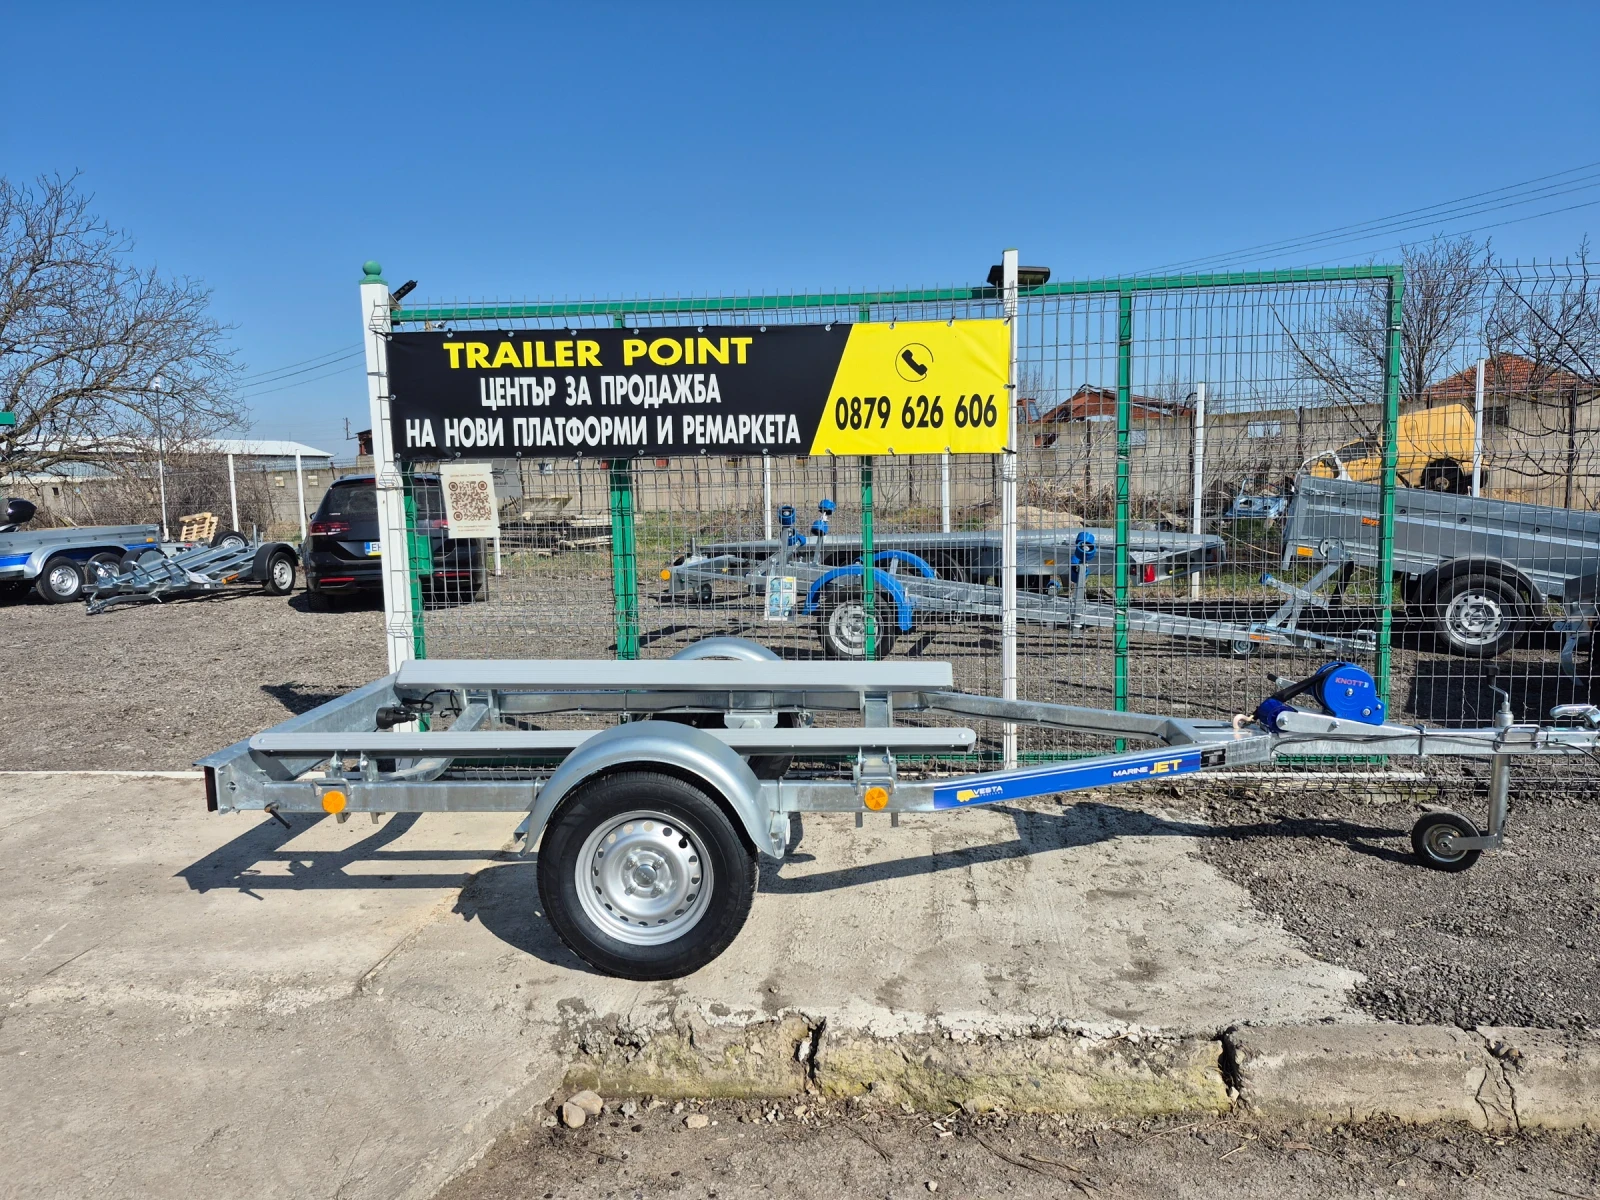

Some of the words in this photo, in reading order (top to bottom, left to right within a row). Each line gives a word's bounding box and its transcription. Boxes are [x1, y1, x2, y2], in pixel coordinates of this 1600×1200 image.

[443, 340, 603, 368] TRAILER
[623, 337, 752, 365] POINT
[481, 377, 556, 410] ЦЕНТЪР
[565, 376, 592, 406] ЗА
[601, 374, 721, 408] ПРОДАЖБА
[836, 396, 890, 430] 0879
[902, 395, 943, 429] 626
[955, 394, 996, 427] 606
[406, 419, 436, 448] НА
[445, 418, 504, 447] НОВИ
[513, 416, 647, 447] ПЛАТФОРМИ
[657, 416, 673, 444] И
[683, 414, 800, 444] РЕМАРКЕТА
[1335, 677, 1363, 687] KNOTT
[1113, 767, 1148, 777] MARINE
[1150, 759, 1182, 774] JET
[973, 785, 1003, 795] VESTA
